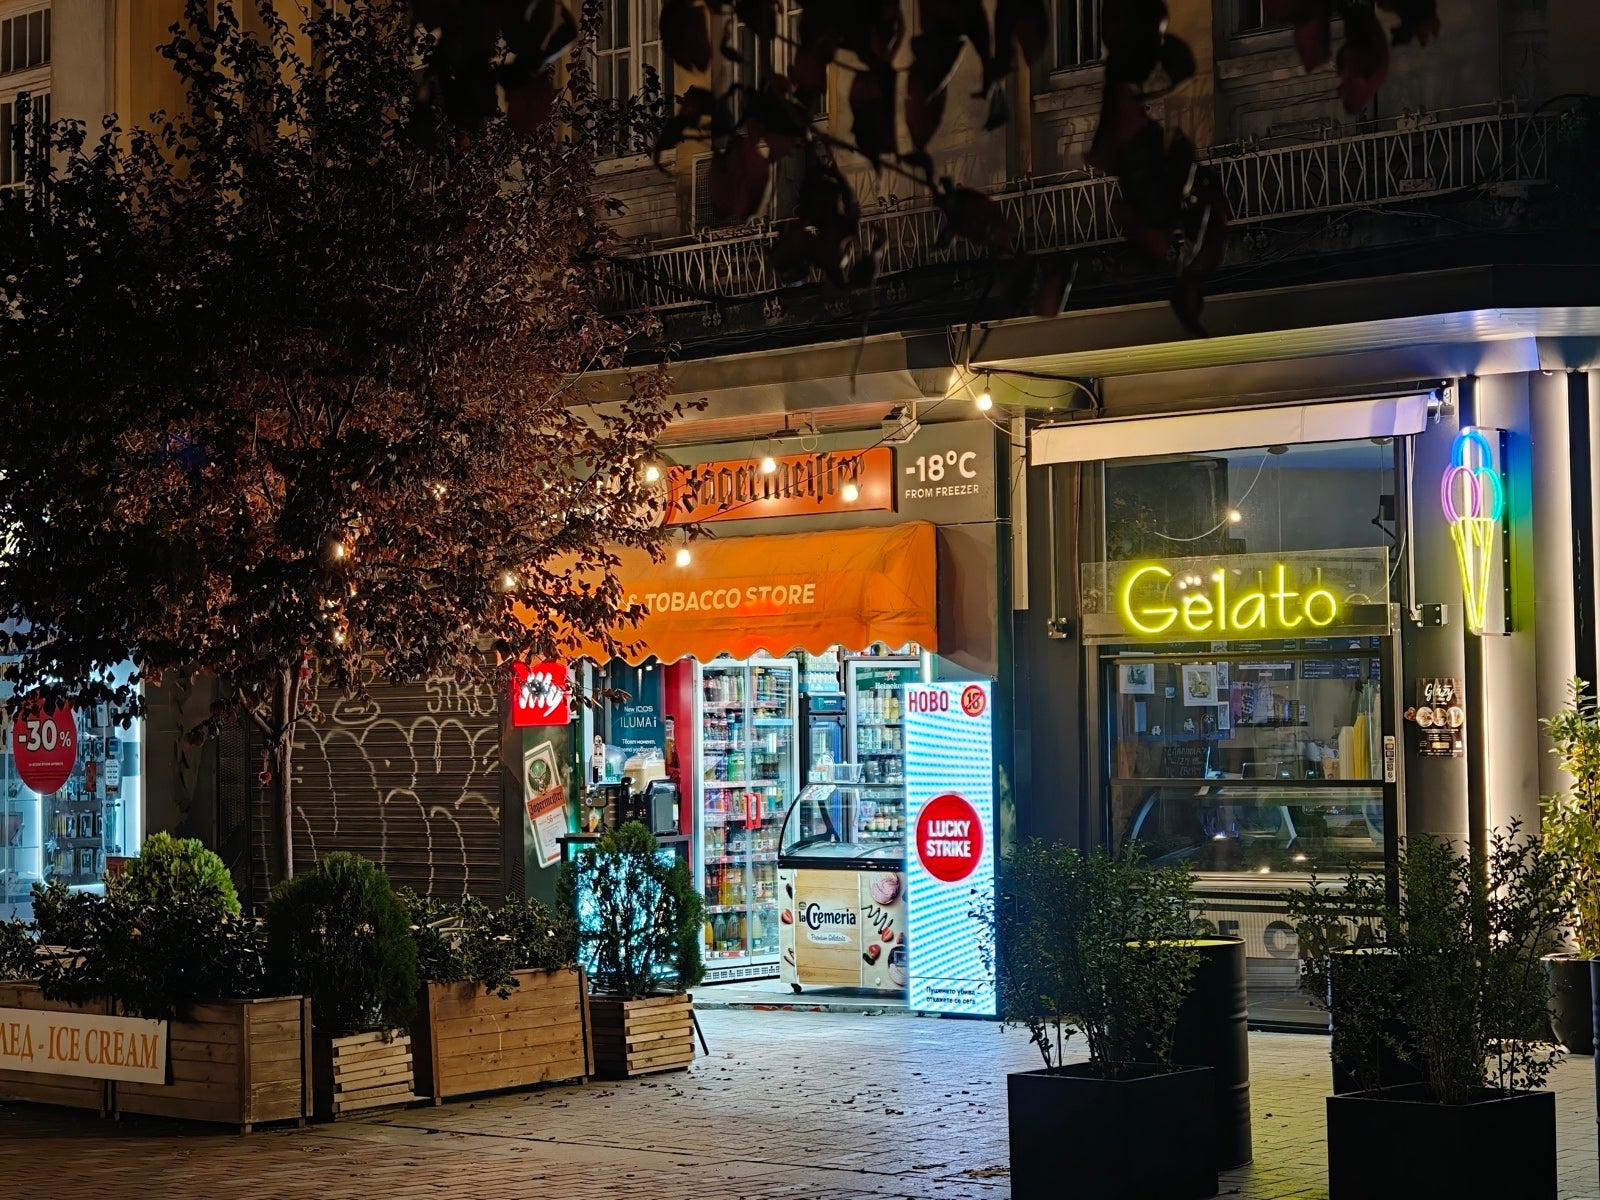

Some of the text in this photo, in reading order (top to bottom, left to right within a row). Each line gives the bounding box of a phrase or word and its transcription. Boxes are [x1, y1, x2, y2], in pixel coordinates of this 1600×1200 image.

[906, 450, 977, 481] -18°C
[905, 484, 980, 499] FROM FREEZER
[646, 587, 741, 613] TOBACCO
[745, 583, 816, 607] STORE
[1124, 564, 1337, 633] Gelato
[621, 717, 652, 728] ILUMA
[928, 820, 971, 837] LUCKY
[926, 839, 972, 857] STRIKE
[806, 902, 856, 930] Cremeria
[48, 1026, 80, 1062] ICE
[85, 1029, 159, 1069] CREAM
